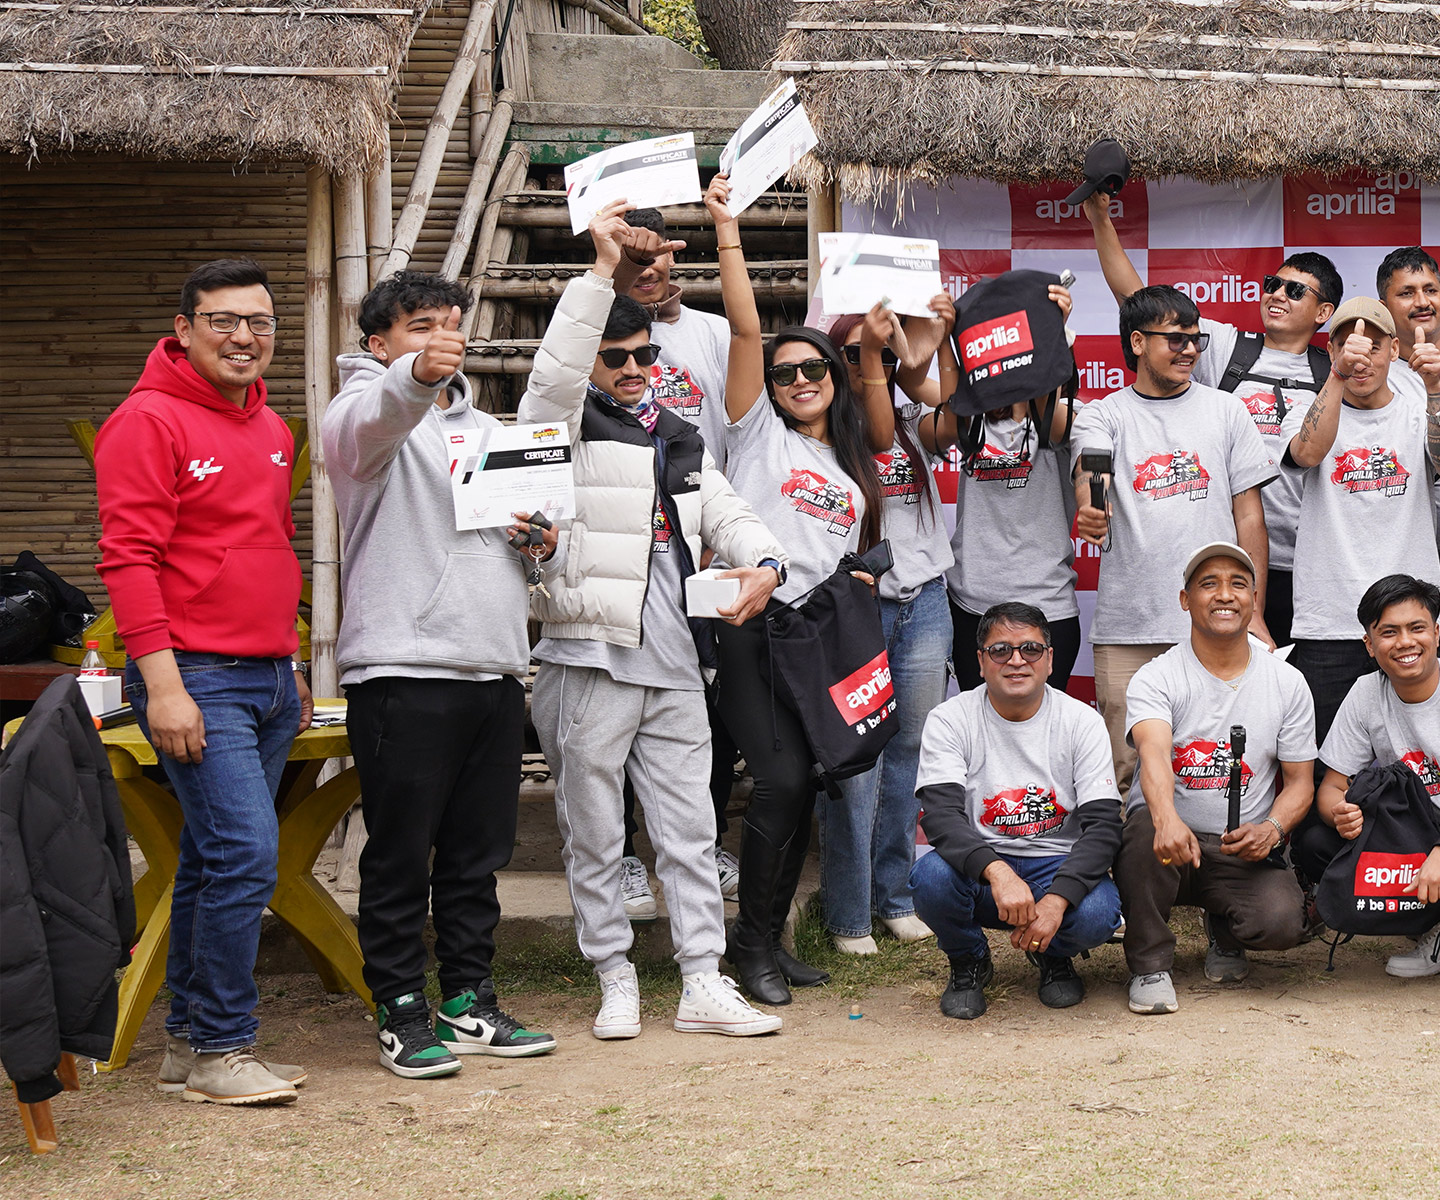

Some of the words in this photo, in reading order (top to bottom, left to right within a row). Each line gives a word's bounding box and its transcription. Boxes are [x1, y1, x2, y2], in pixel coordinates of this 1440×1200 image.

[642, 150, 688, 164] CERTIFICATE
[1035, 199, 1124, 224] apra
[1306, 187, 1395, 220] aprilia
[965, 325, 1021, 359] aprilia
[974, 369, 989, 382] be
[991, 364, 1000, 374] a
[1002, 353, 1034, 371] racer
[1077, 361, 1125, 389] rilia
[1253, 414, 1277, 424] PRILIA
[524, 449, 565, 462] CERTIFICATE
[1008, 478, 1027, 488] RIDE
[1144, 474, 1177, 490] APRILIA
[1342, 470, 1374, 482] APRILIA
[1351, 474, 1406, 492] ADVENTURE
[1155, 478, 1209, 499] ADVENTURE
[1190, 488, 1209, 500] RIDE
[1386, 485, 1405, 496] RIDE
[791, 487, 826, 508] APRILIA
[798, 502, 854, 528] ADVENTURE
[828, 523, 849, 536] RIDE
[845, 666, 892, 708] aprilia
[856, 723, 867, 736] #
[866, 715, 881, 729] be
[881, 709, 887, 719] a
[1179, 766, 1216, 777] APRILIA
[994, 813, 1029, 827] APRILIA
[1007, 815, 1063, 837] ADVENTURE
[1356, 899, 1366, 910] #
[1369, 899, 1385, 910] be
[1388, 901, 1396, 910] a
